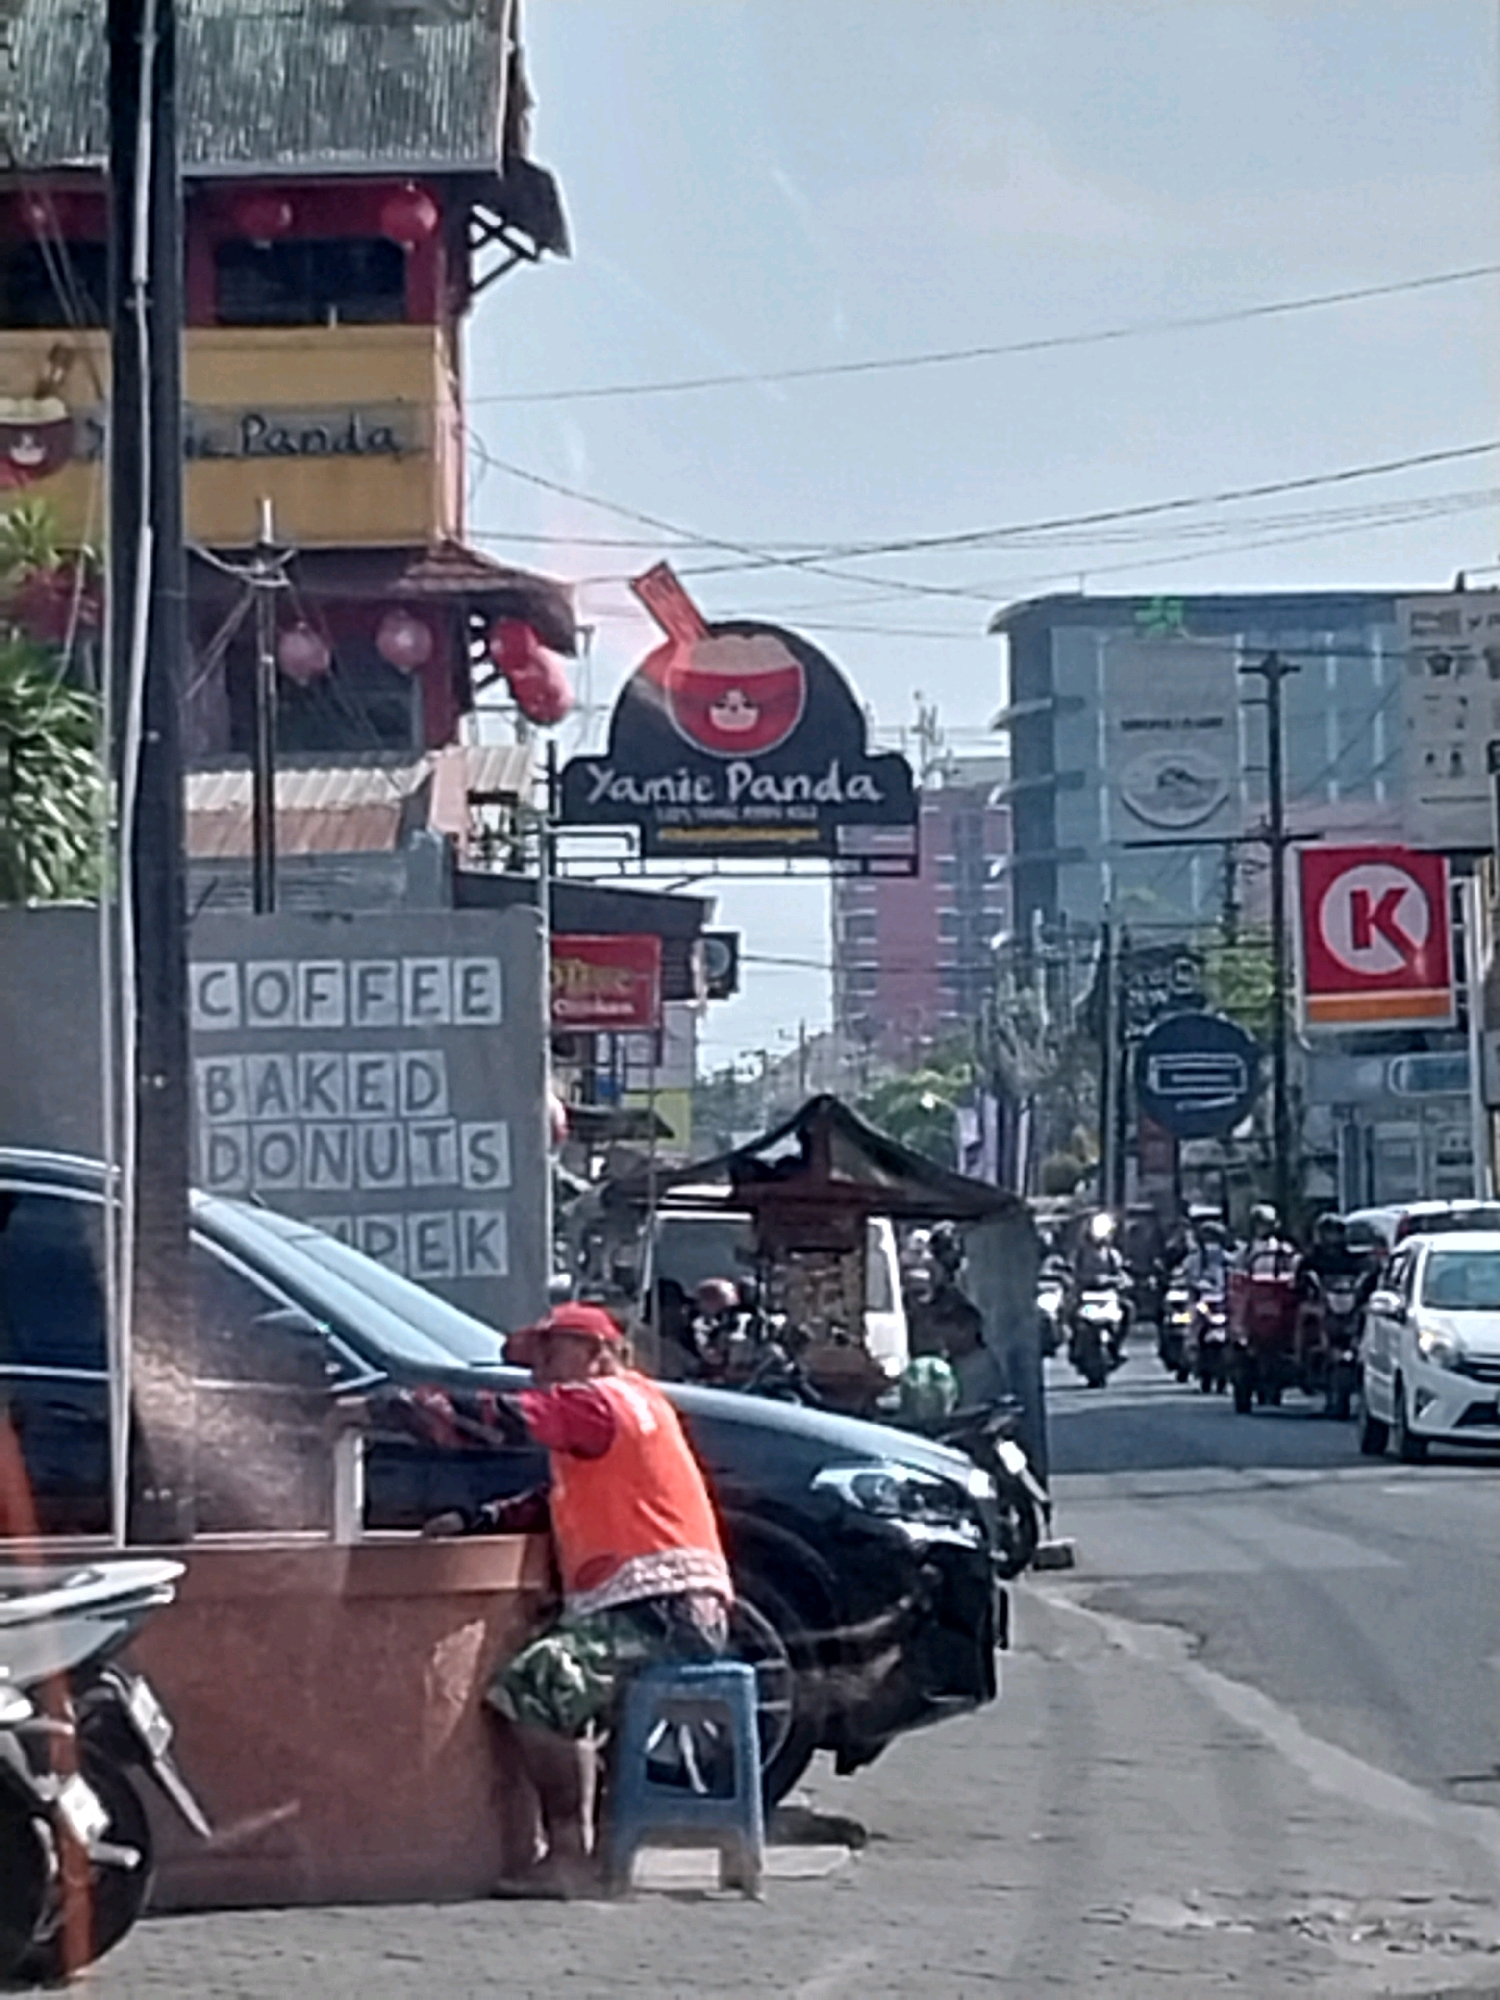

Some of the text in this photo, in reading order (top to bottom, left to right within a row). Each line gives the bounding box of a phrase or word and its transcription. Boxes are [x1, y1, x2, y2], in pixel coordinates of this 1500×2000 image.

[243, 413, 402, 456] Panda
[726, 758, 885, 801] Panda
[198, 964, 493, 1022] COFFEE
[205, 1058, 441, 1117] BAKED
[207, 1125, 500, 1184] DONUTS
